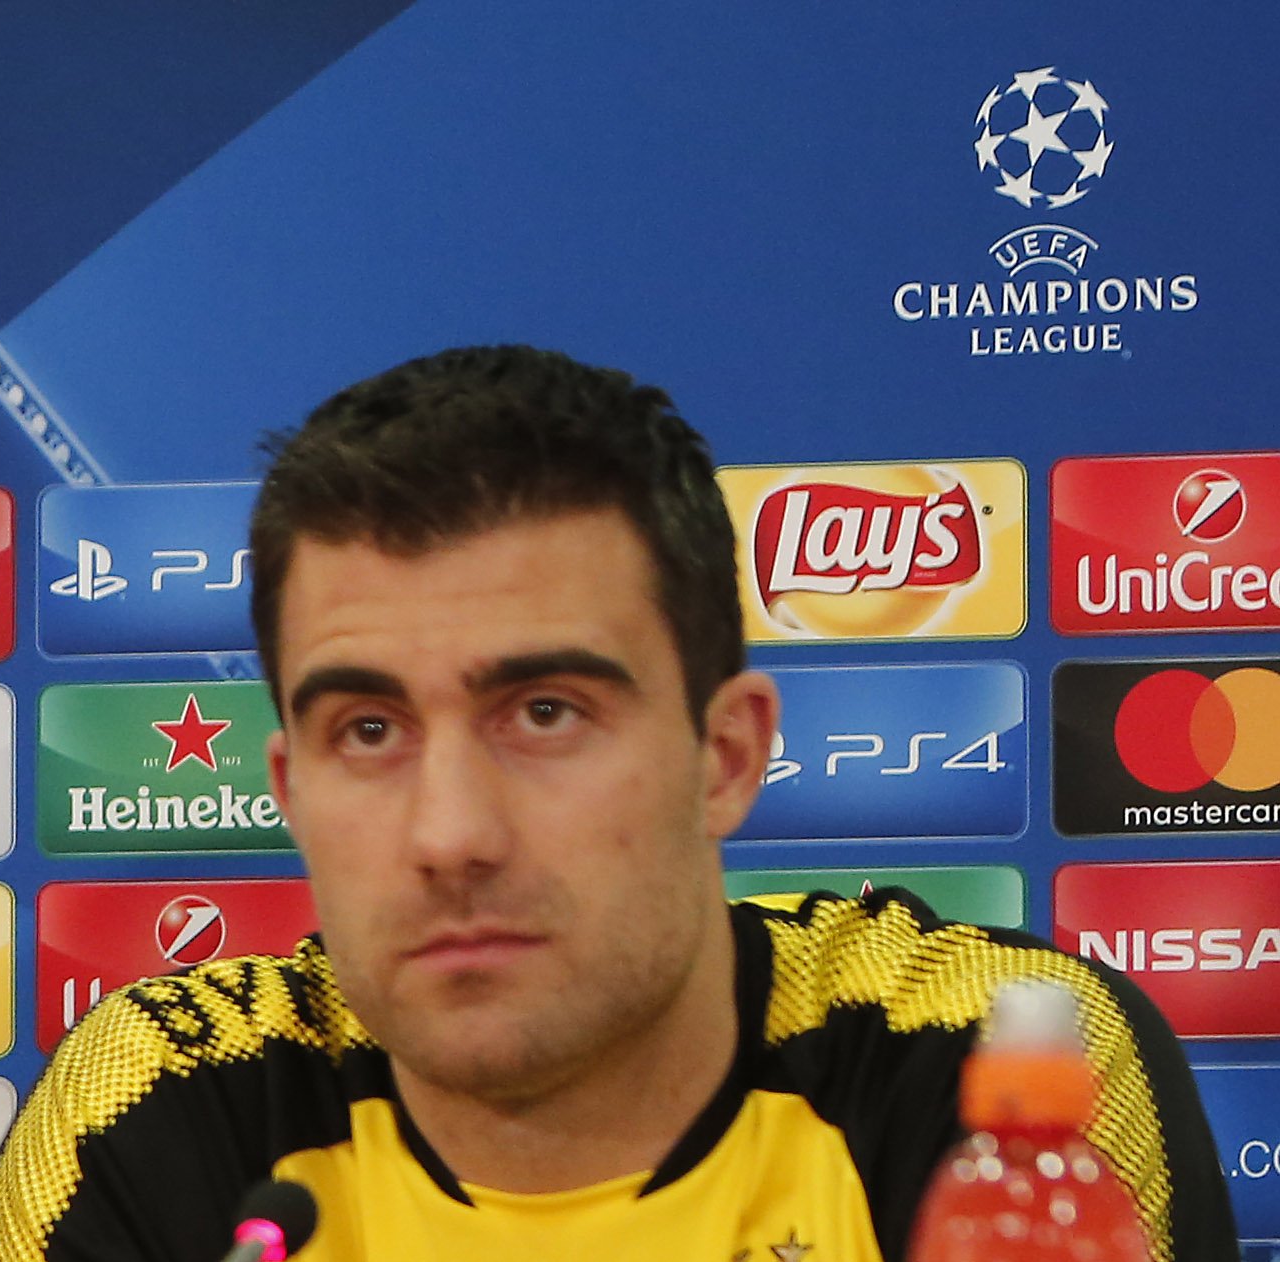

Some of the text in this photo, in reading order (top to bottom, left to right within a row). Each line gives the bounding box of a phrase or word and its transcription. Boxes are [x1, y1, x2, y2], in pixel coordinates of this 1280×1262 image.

[995, 233, 1088, 269] UEFA
[893, 275, 1199, 321] CHAMPIONS
[970, 324, 1123, 356] LEAGUE
[768, 489, 966, 594] Lay's
[152, 549, 252, 591] PS
[825, 731, 1008, 777] PS4
[67, 784, 289, 831] Heineke
[1123, 799, 1280, 826] mastercar
[1079, 928, 1280, 973] NISSA
